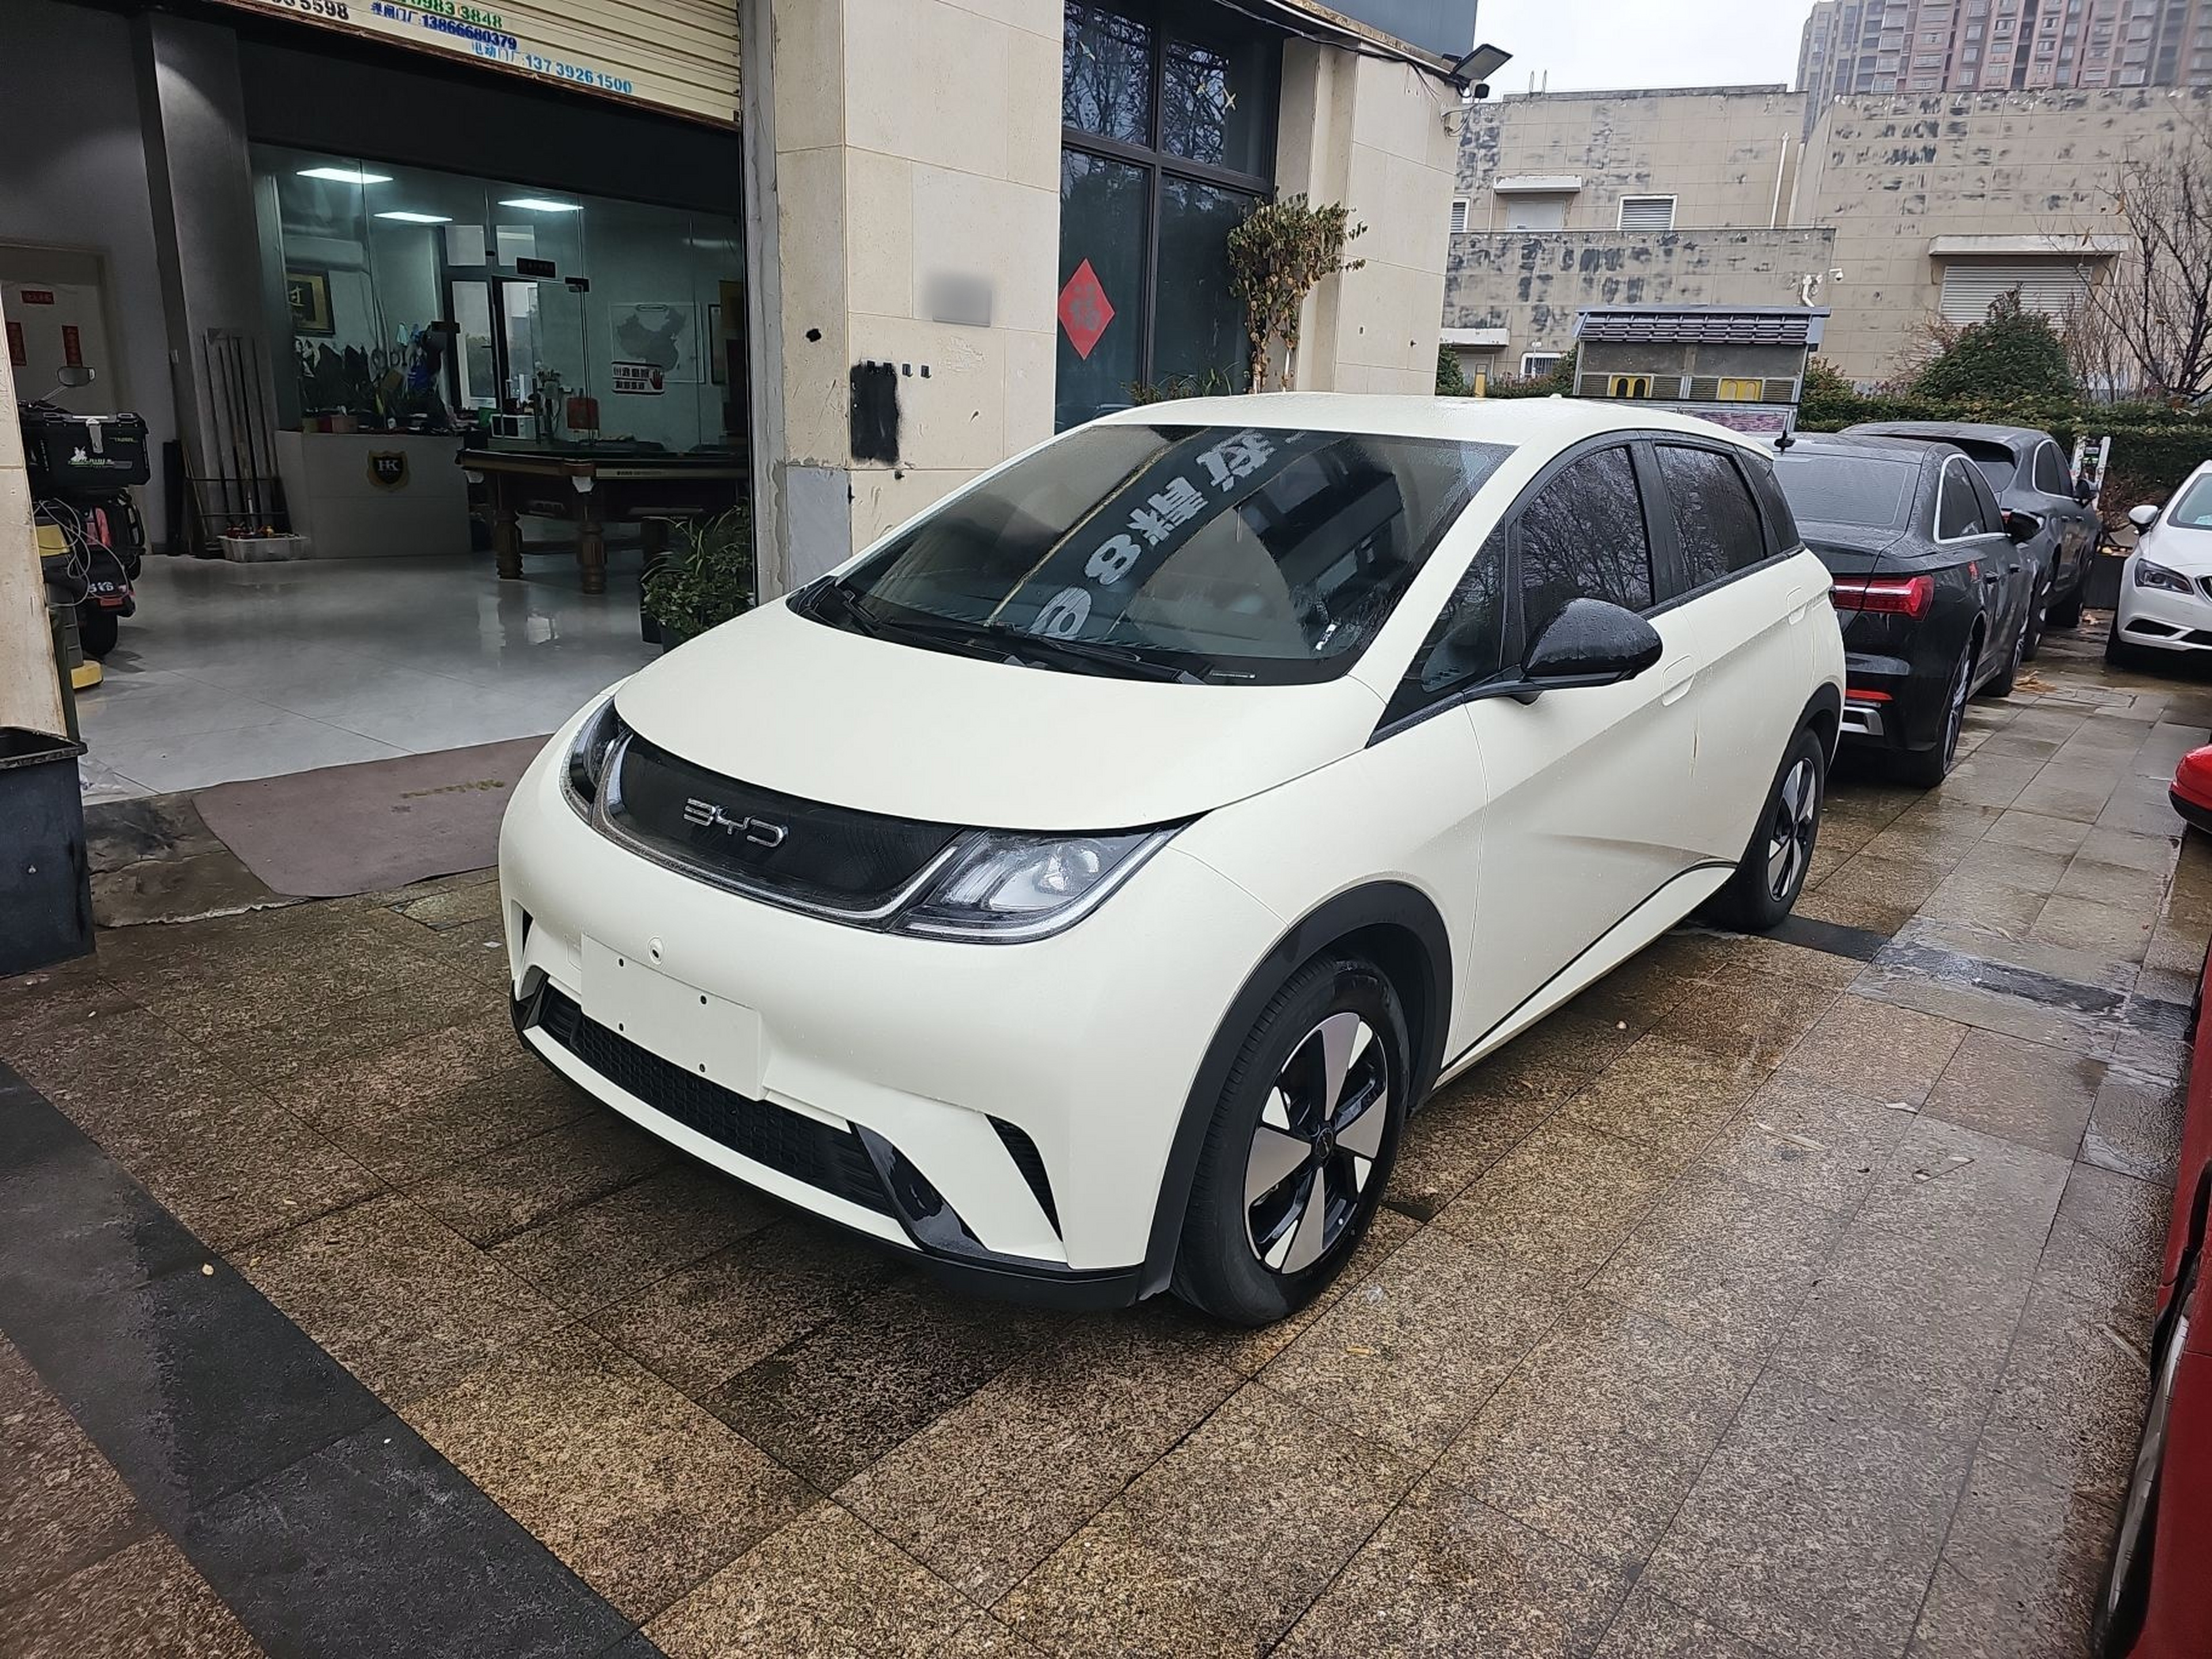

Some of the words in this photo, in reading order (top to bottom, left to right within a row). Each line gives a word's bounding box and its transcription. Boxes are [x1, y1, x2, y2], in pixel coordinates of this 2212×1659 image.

[555, 62, 593, 84] 3926
[596, 73, 632, 93] 1500
[684, 798, 785, 847] BYD
